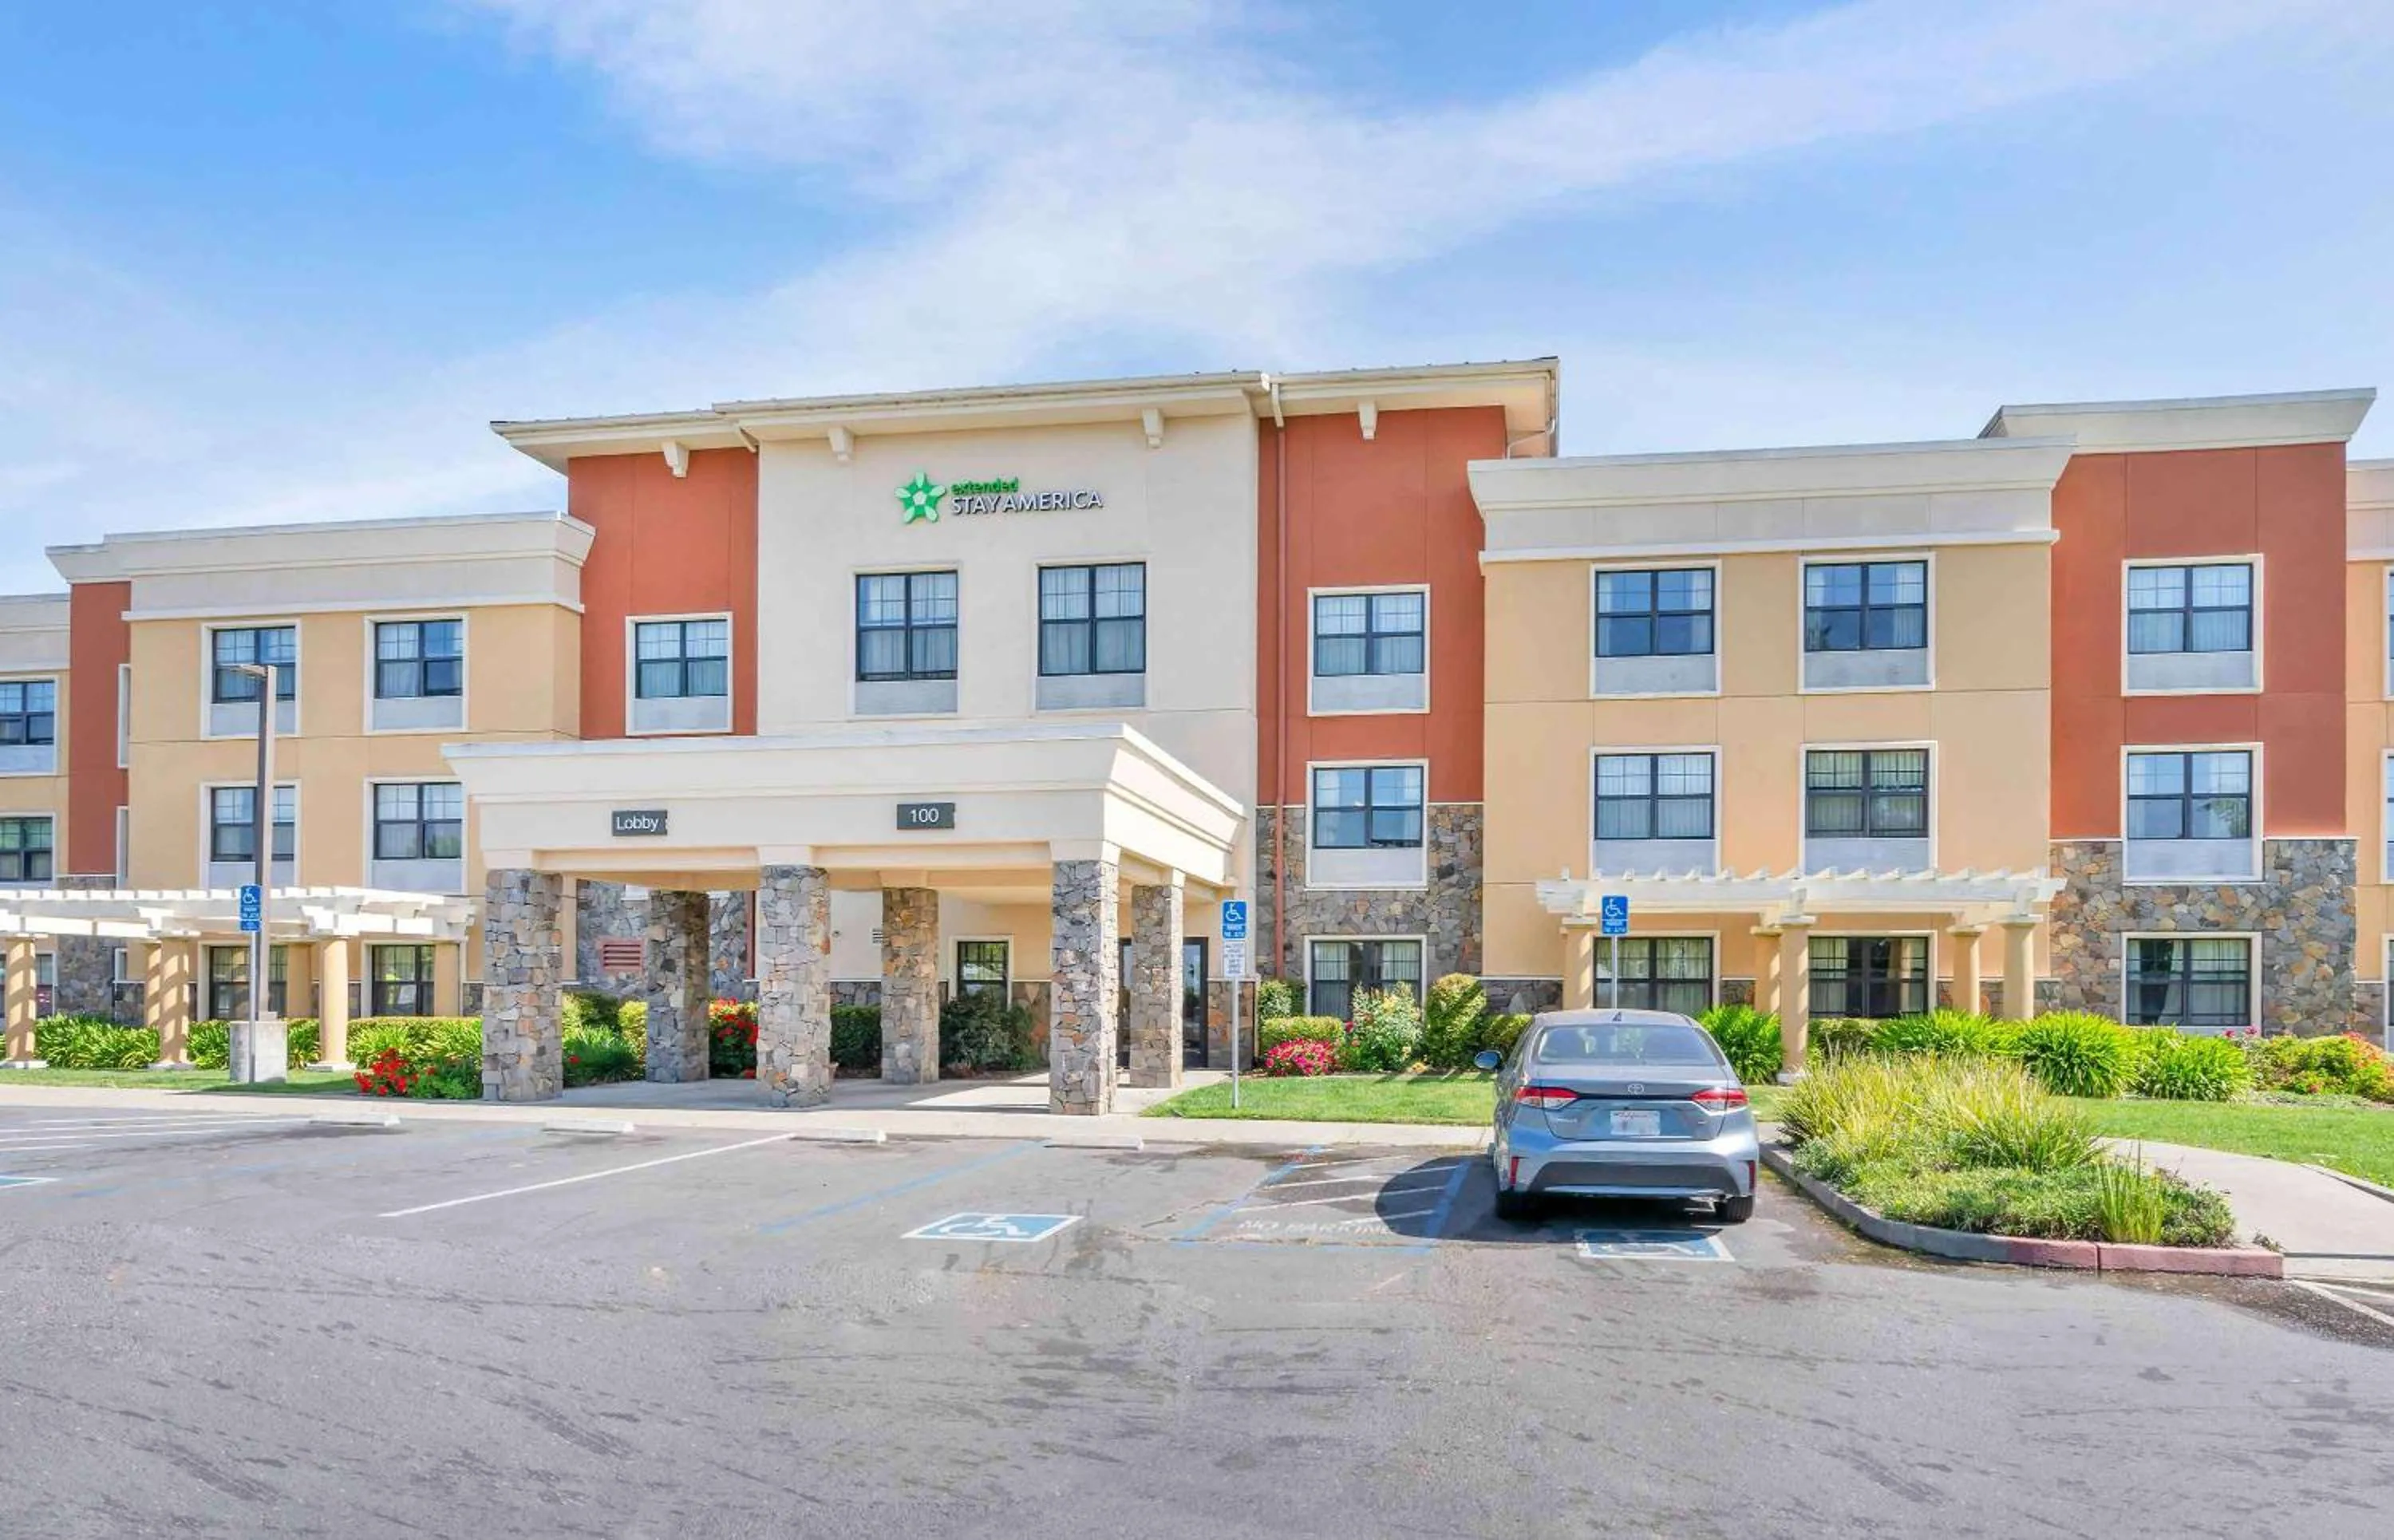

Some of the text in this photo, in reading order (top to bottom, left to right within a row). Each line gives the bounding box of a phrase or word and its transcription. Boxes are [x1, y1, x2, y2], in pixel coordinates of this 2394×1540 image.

[951, 478, 1019, 495] extended
[951, 490, 1103, 515] STAY AMERICA
[616, 814, 659, 832] Lobby
[910, 808, 939, 823] 100
